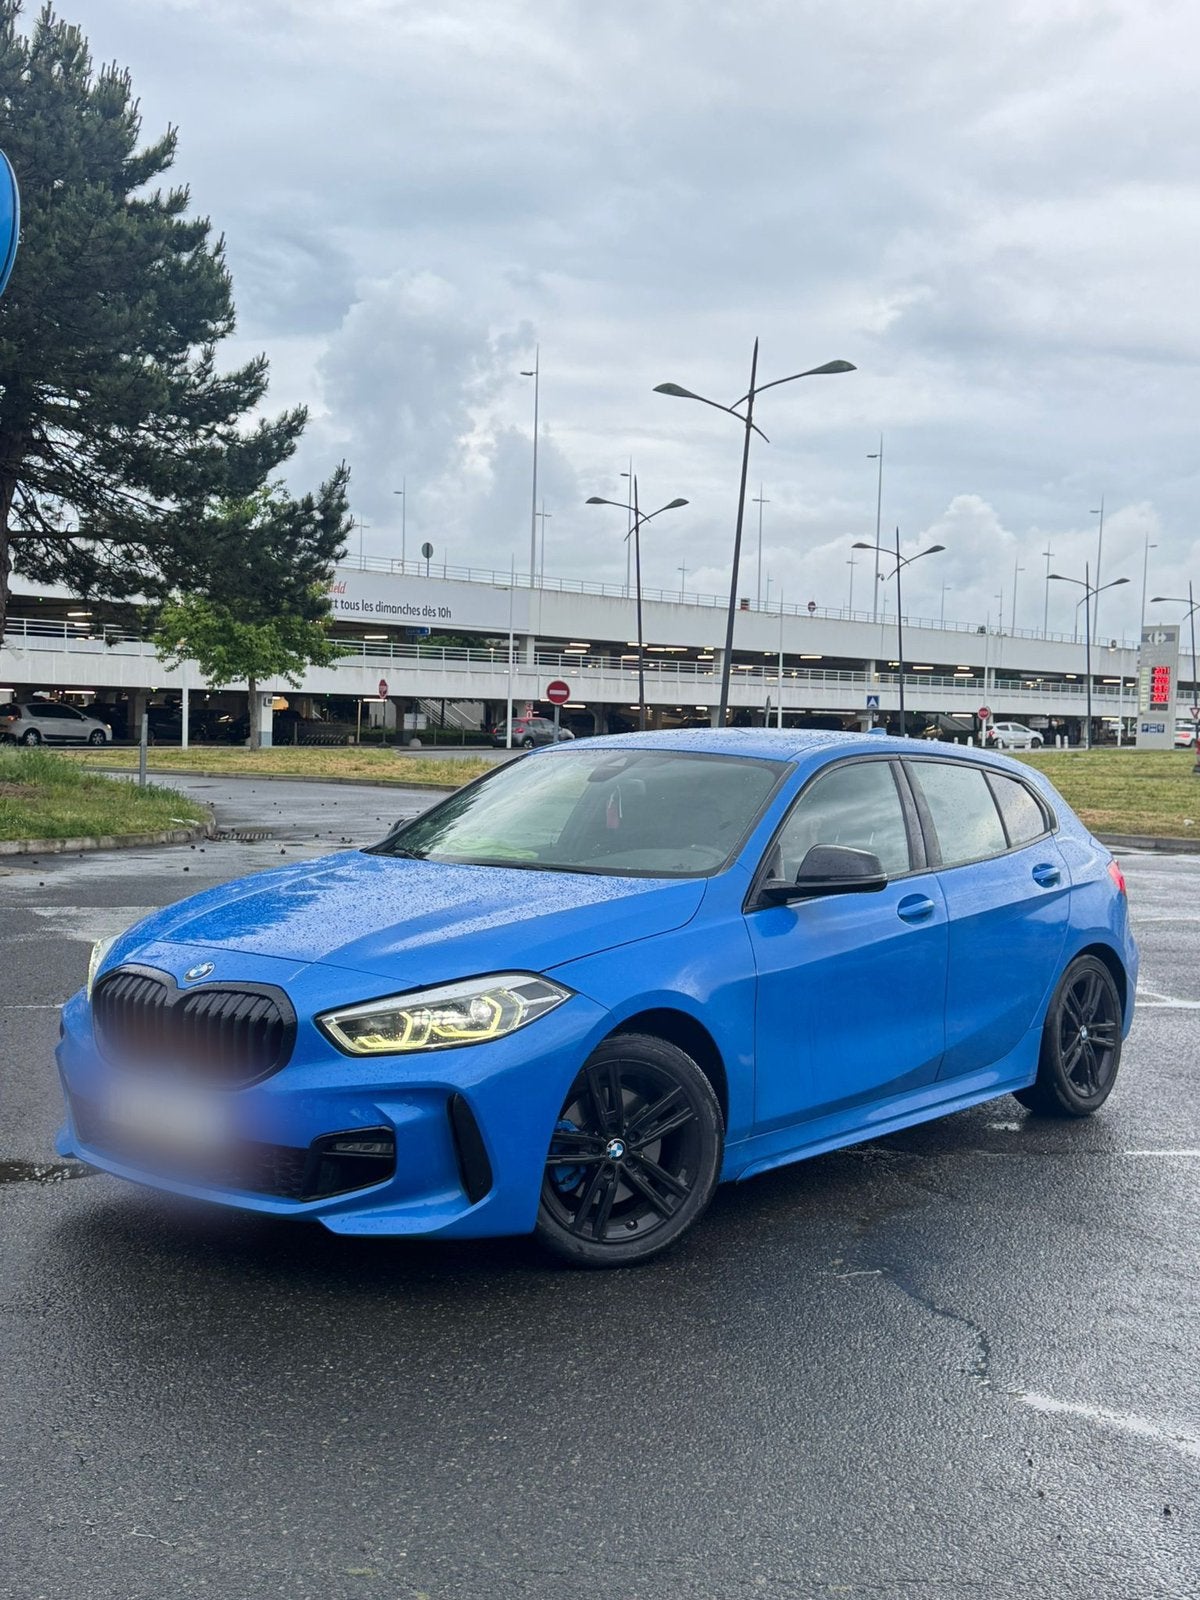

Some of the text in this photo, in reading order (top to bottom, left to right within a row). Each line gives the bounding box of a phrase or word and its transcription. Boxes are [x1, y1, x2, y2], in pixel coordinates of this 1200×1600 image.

[341, 600, 360, 611] tous
[361, 599, 374, 612] les
[375, 601, 420, 616] dimanches
[422, 605, 436, 616] dès
[438, 607, 451, 618] 10h
